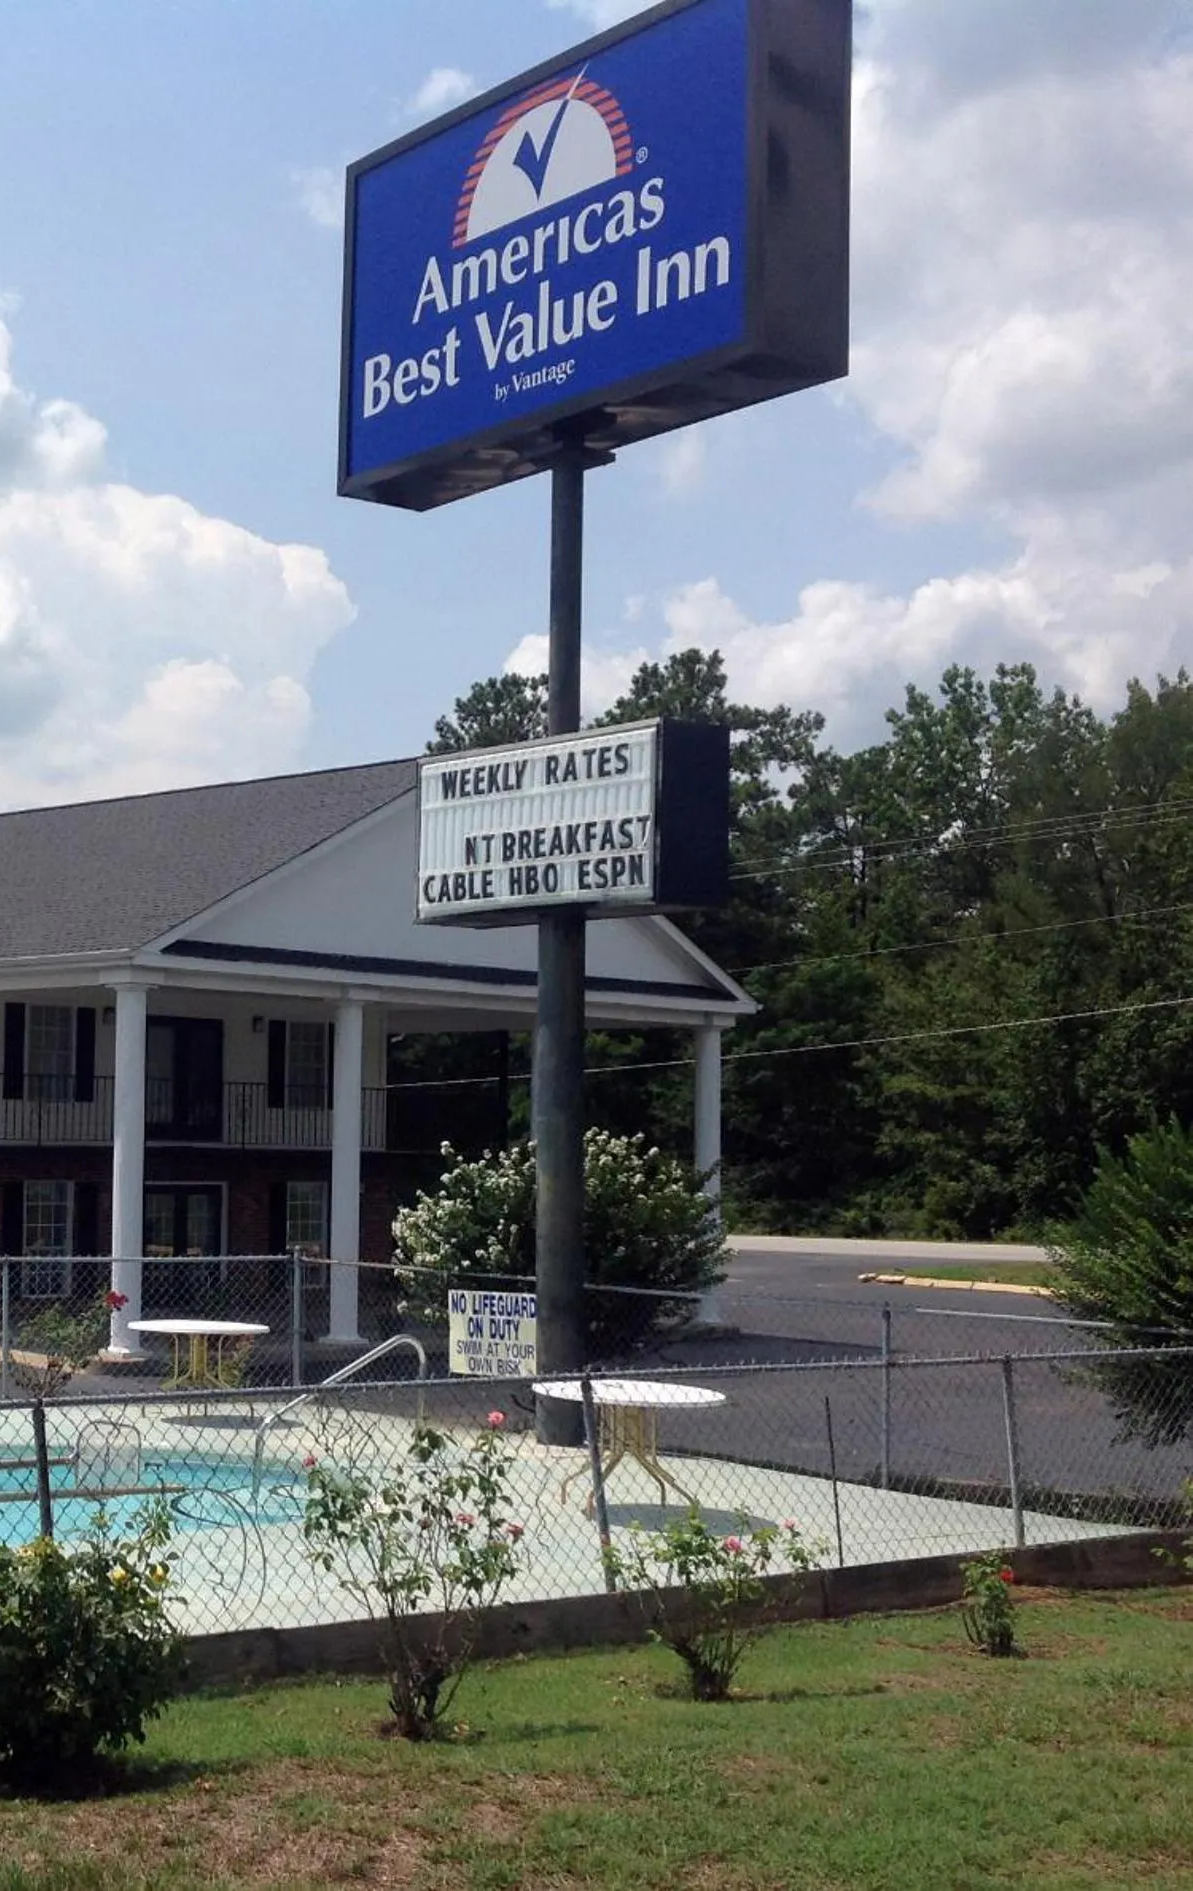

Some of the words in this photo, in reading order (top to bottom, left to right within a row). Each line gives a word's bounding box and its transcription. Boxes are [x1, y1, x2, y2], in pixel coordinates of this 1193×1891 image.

[412, 177, 665, 325] Americas
[363, 327, 460, 418] Best
[475, 280, 618, 371] Value
[636, 236, 731, 315] Inn
[494, 384, 510, 402] by
[512, 359, 575, 393] Vantage
[441, 760, 528, 800] WEEKLY
[545, 743, 630, 785] RATES
[502, 816, 651, 862] BREAKFAST
[423, 870, 494, 904] CABLE
[509, 863, 558, 896] HBO
[578, 854, 644, 890] ESPN
[451, 1292, 466, 1314] NO
[472, 1294, 538, 1318] LIFEGUARD
[457, 1340, 483, 1356] SWIM
[487, 1343, 500, 1357] AT
[505, 1343, 535, 1360] YOUR
[468, 1317, 484, 1338] ON
[490, 1318, 521, 1340] DUTY
[468, 1357, 493, 1374] OWN
